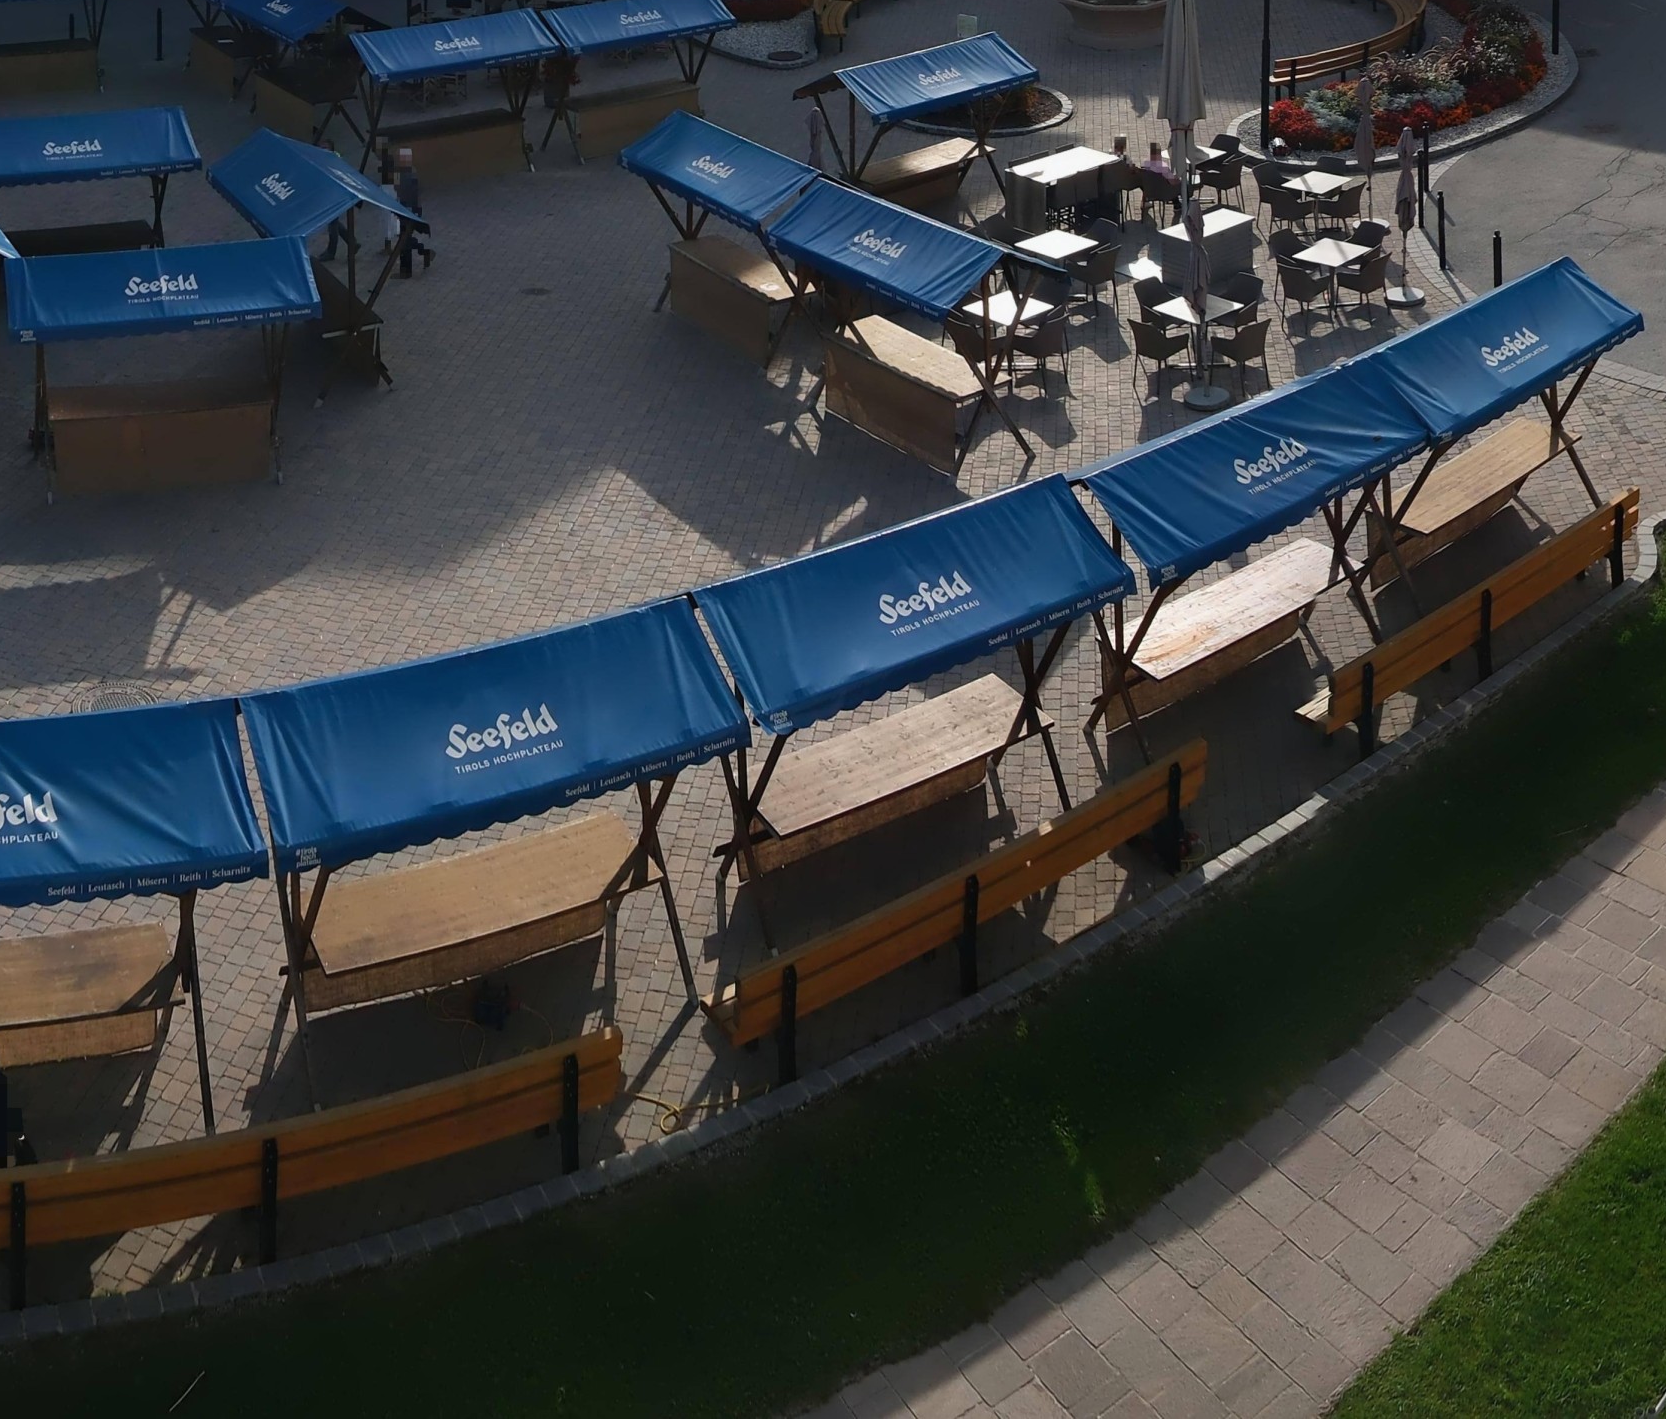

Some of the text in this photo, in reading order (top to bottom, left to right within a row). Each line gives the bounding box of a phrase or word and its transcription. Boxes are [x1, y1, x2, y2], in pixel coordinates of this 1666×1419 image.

[620, 10, 662, 25] Seefeld
[434, 36, 480, 52] Seefeld
[918, 67, 961, 86] Seefeld
[43, 139, 102, 156] Seefeld
[691, 155, 735, 179] Seefeld
[853, 228, 907, 258] Seefeld
[124, 274, 199, 296] Seefeld
[1481, 327, 1540, 367] Seefeld
[1234, 436, 1309, 485] Seefeld
[1248, 459, 1317, 496] TIROLS HOCHPLATEAU
[878, 570, 972, 625] Seefeld
[891, 598, 980, 637] TIROLS HOCHPLATEAU
[445, 703, 558, 759] Seefeld
[455, 739, 564, 774] TIROLS HOCHPLATEAU
[565, 736, 735, 798] Seefeld Leutasch Mösern Reith Scharnitz
[48, 866, 251, 897] Seefeld Leutasch Mösern Reith Scharnitz
